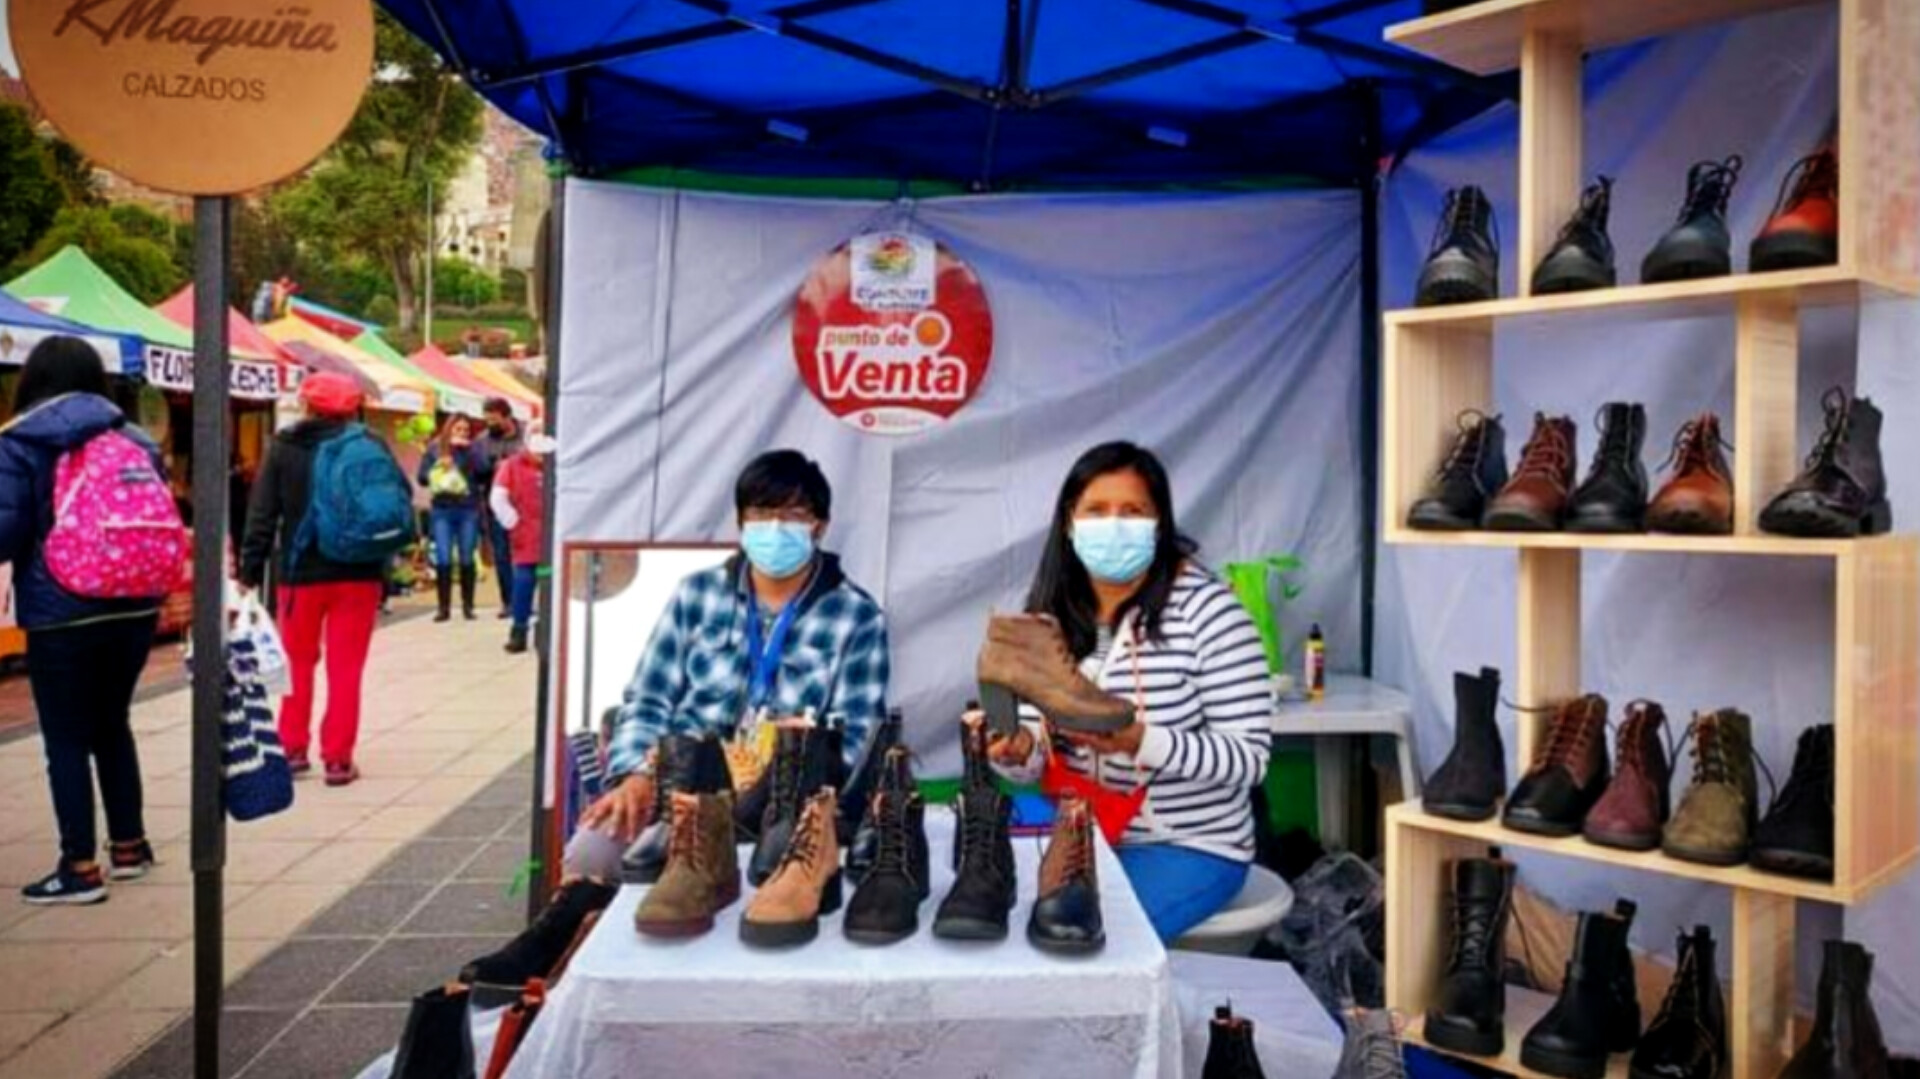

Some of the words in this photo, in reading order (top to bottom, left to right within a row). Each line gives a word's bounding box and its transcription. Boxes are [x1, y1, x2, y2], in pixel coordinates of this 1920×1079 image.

[122, 72, 267, 101] CALZADOS
[825, 328, 880, 348] punto
[885, 328, 910, 347] de
[823, 352, 962, 394] Venta
